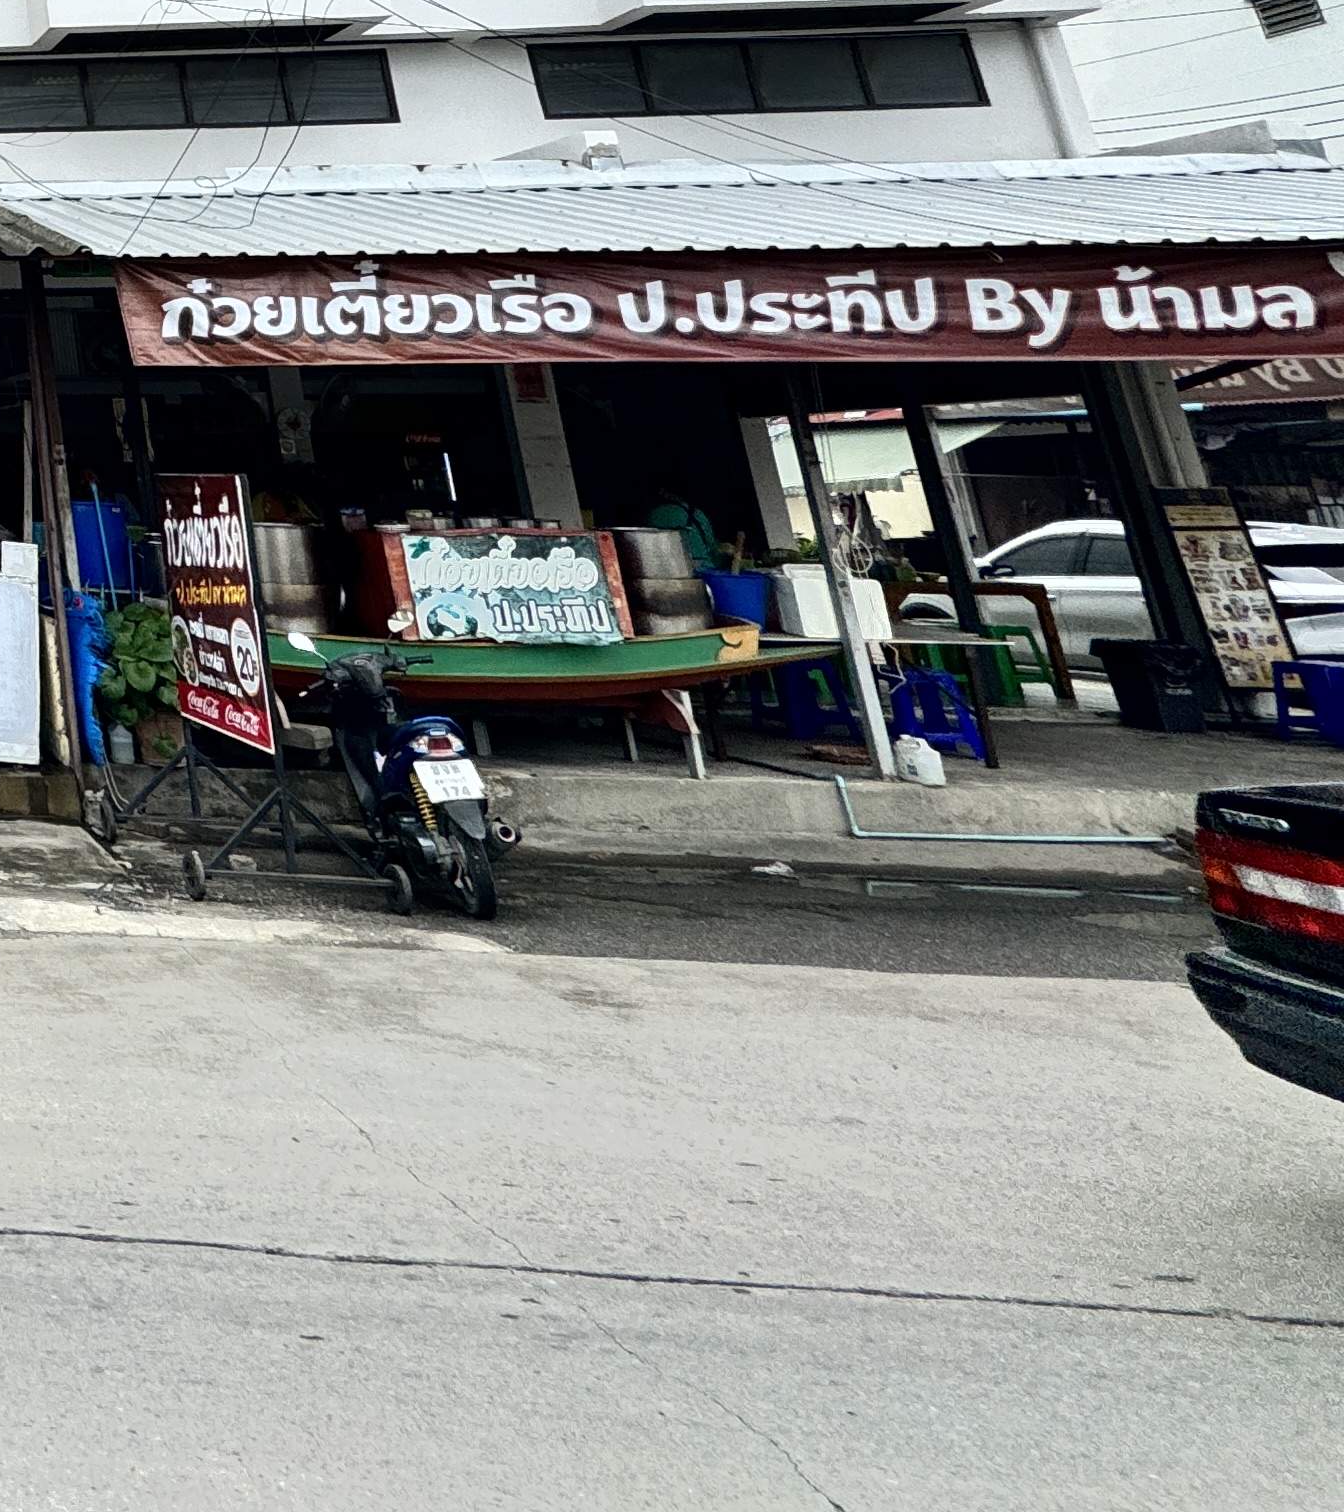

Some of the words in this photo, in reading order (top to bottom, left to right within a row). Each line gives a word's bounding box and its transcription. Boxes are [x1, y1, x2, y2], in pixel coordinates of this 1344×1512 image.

[161, 259, 592, 338] ก๋วยเตี๋ยวเรือ
[616, 269, 934, 334] ป.ประทีป
[964, 277, 1072, 348] By
[1099, 265, 1315, 331] น้ามล
[493, 596, 613, 634] ป.ประทีป
